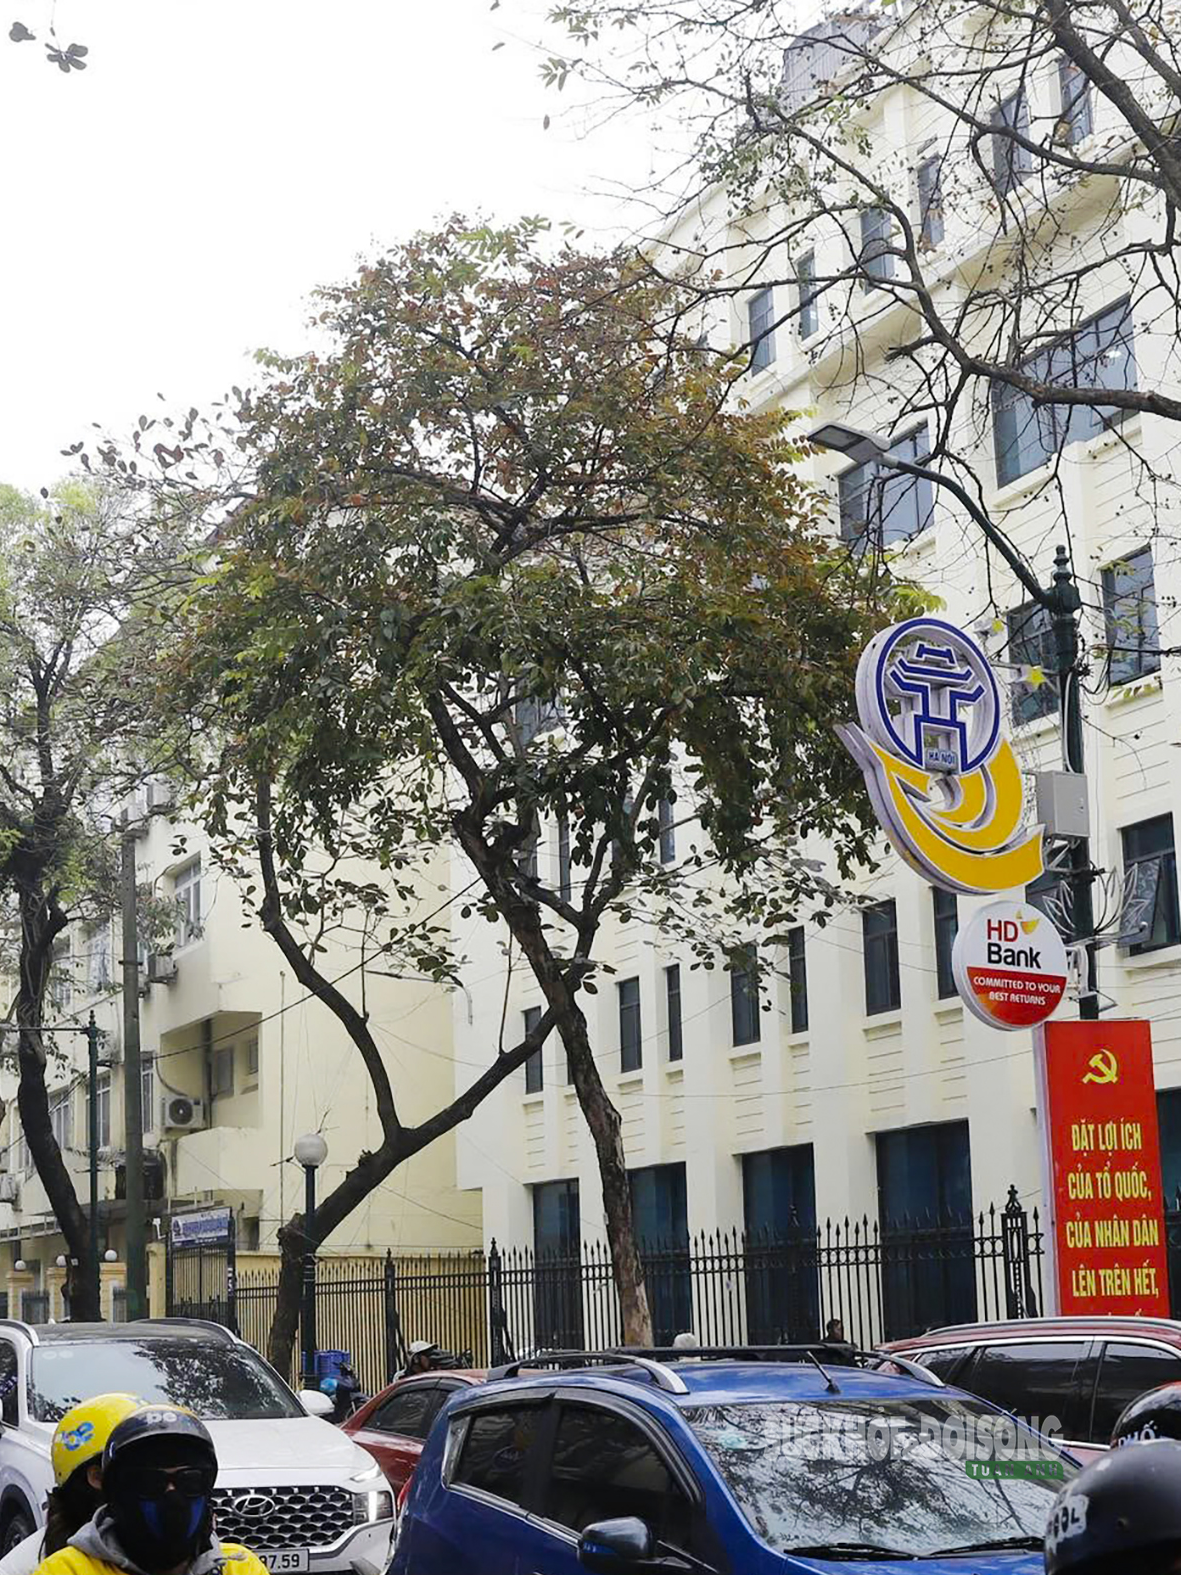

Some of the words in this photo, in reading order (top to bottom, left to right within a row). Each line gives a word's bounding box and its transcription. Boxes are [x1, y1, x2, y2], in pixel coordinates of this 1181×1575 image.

[987, 918, 1019, 942] HD
[987, 942, 1041, 969] Bank
[973, 976, 1024, 990] COMMITTED
[1025, 982, 1036, 991] TO
[1037, 983, 1061, 994] YOUR
[989, 991, 1009, 1002] BEST
[1010, 992, 1046, 1006] RETURNS
[1071, 1118, 1094, 1157] ĐẶT
[1098, 1121, 1118, 1157] LỢI
[1120, 1117, 1142, 1151] ÍCH
[1068, 1163, 1094, 1199] CỦA
[1095, 1160, 1112, 1199] TỔ
[1114, 1162, 1152, 1201] QUỐC,
[1066, 1211, 1092, 1248] CỦA
[1094, 1213, 1130, 1248] NHÂN
[1132, 1213, 1159, 1247] DÂN
[1072, 1263, 1096, 1297] LÊN
[1098, 1263, 1131, 1296] TRÊN
[1133, 1259, 1159, 1299] HẾT,
